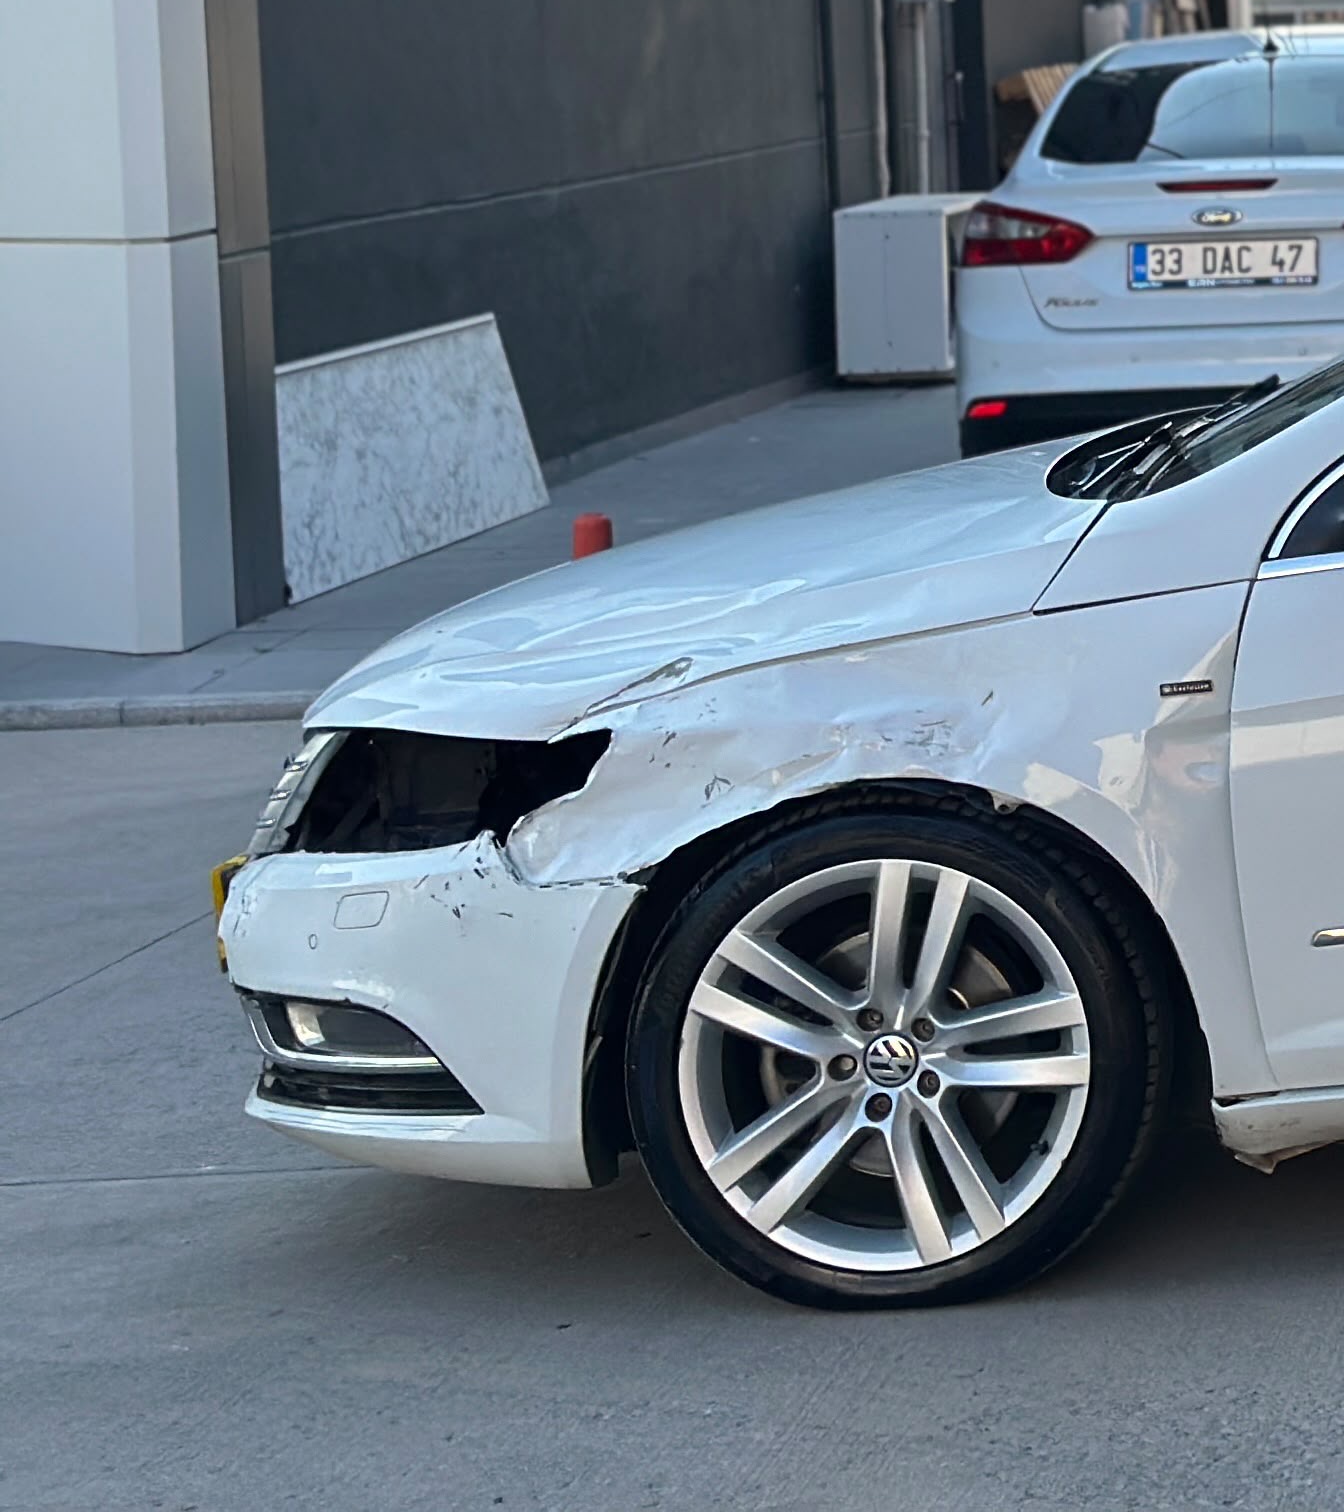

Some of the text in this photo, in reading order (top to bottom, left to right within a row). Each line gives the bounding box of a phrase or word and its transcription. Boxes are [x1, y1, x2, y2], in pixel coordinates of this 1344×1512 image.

[1151, 243, 1303, 276] 33 DAC 47
